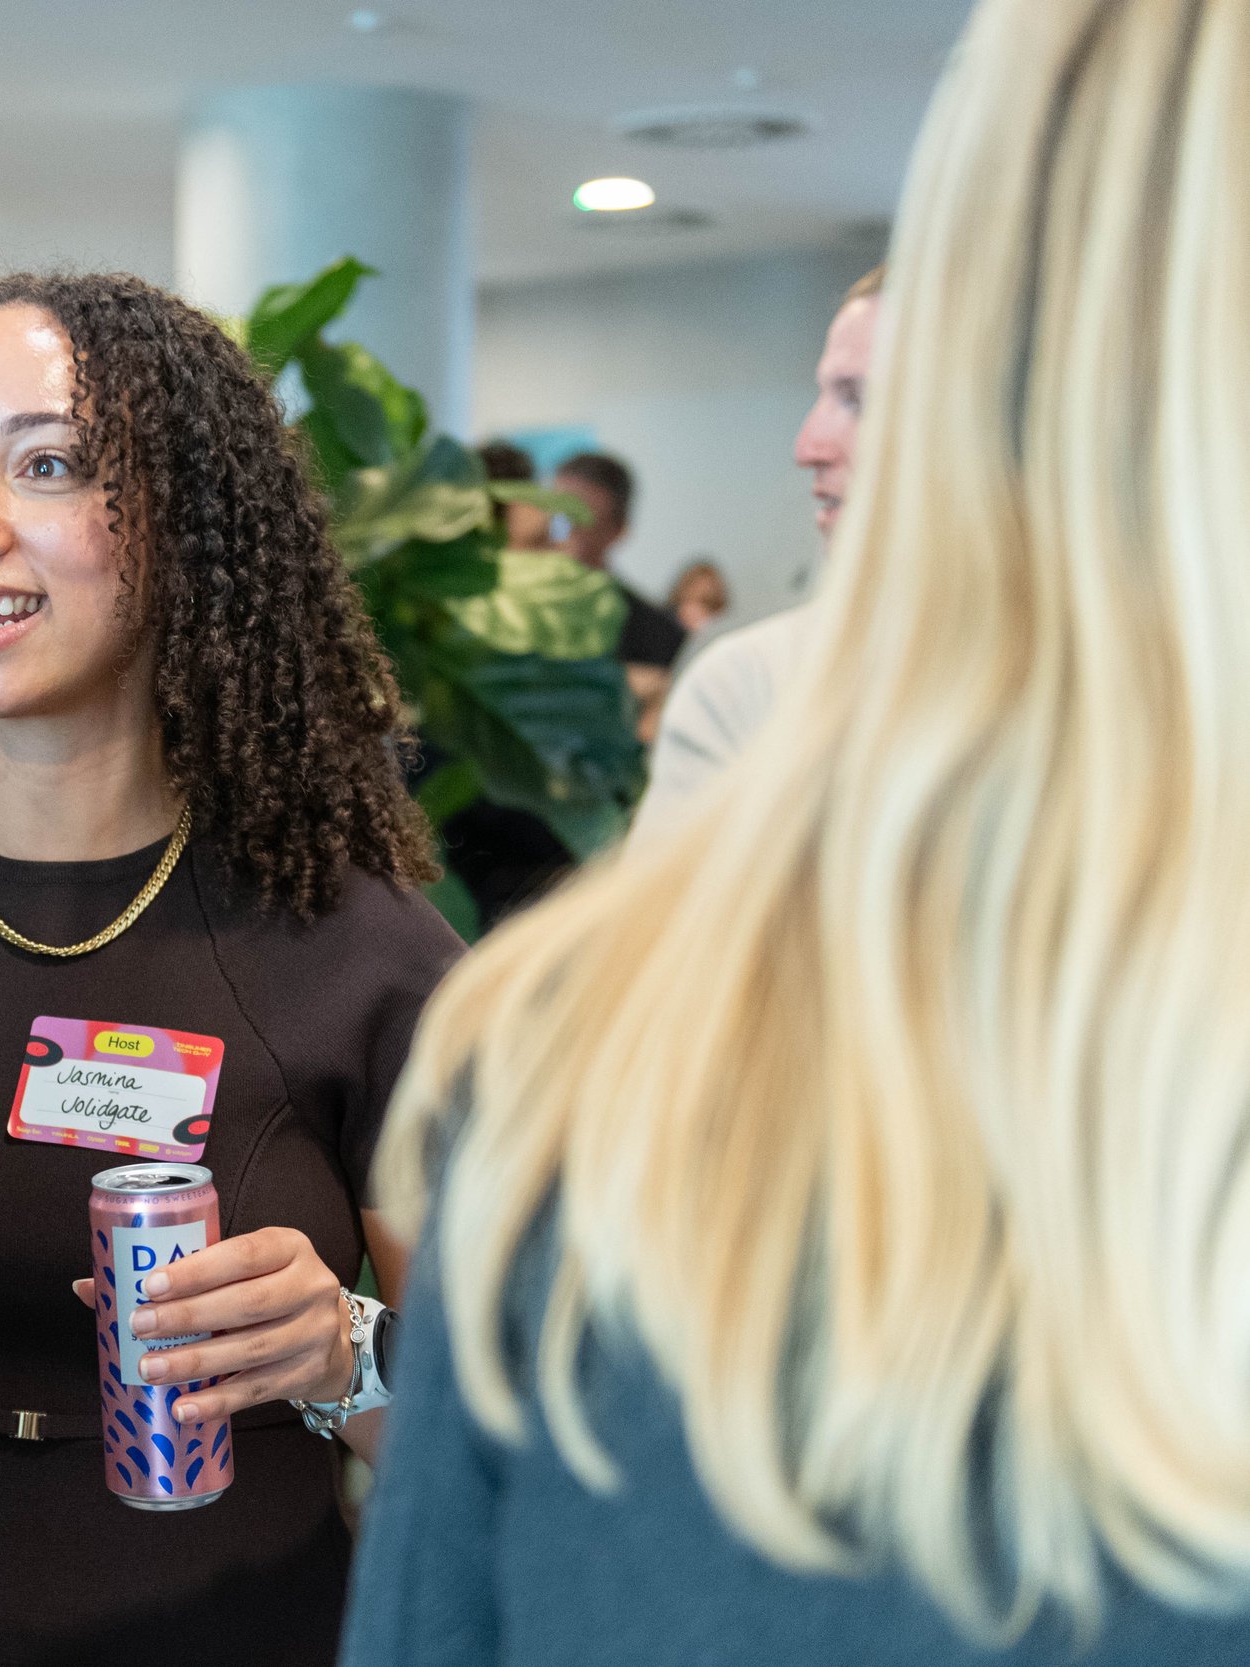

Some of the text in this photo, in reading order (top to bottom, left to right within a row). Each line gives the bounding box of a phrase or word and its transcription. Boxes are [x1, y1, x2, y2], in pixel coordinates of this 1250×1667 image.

[108, 1036, 140, 1051] Host
[56, 1065, 143, 1090] Jasmina
[105, 1194, 135, 1205] SUGAR
[144, 1197, 159, 1205] NO
